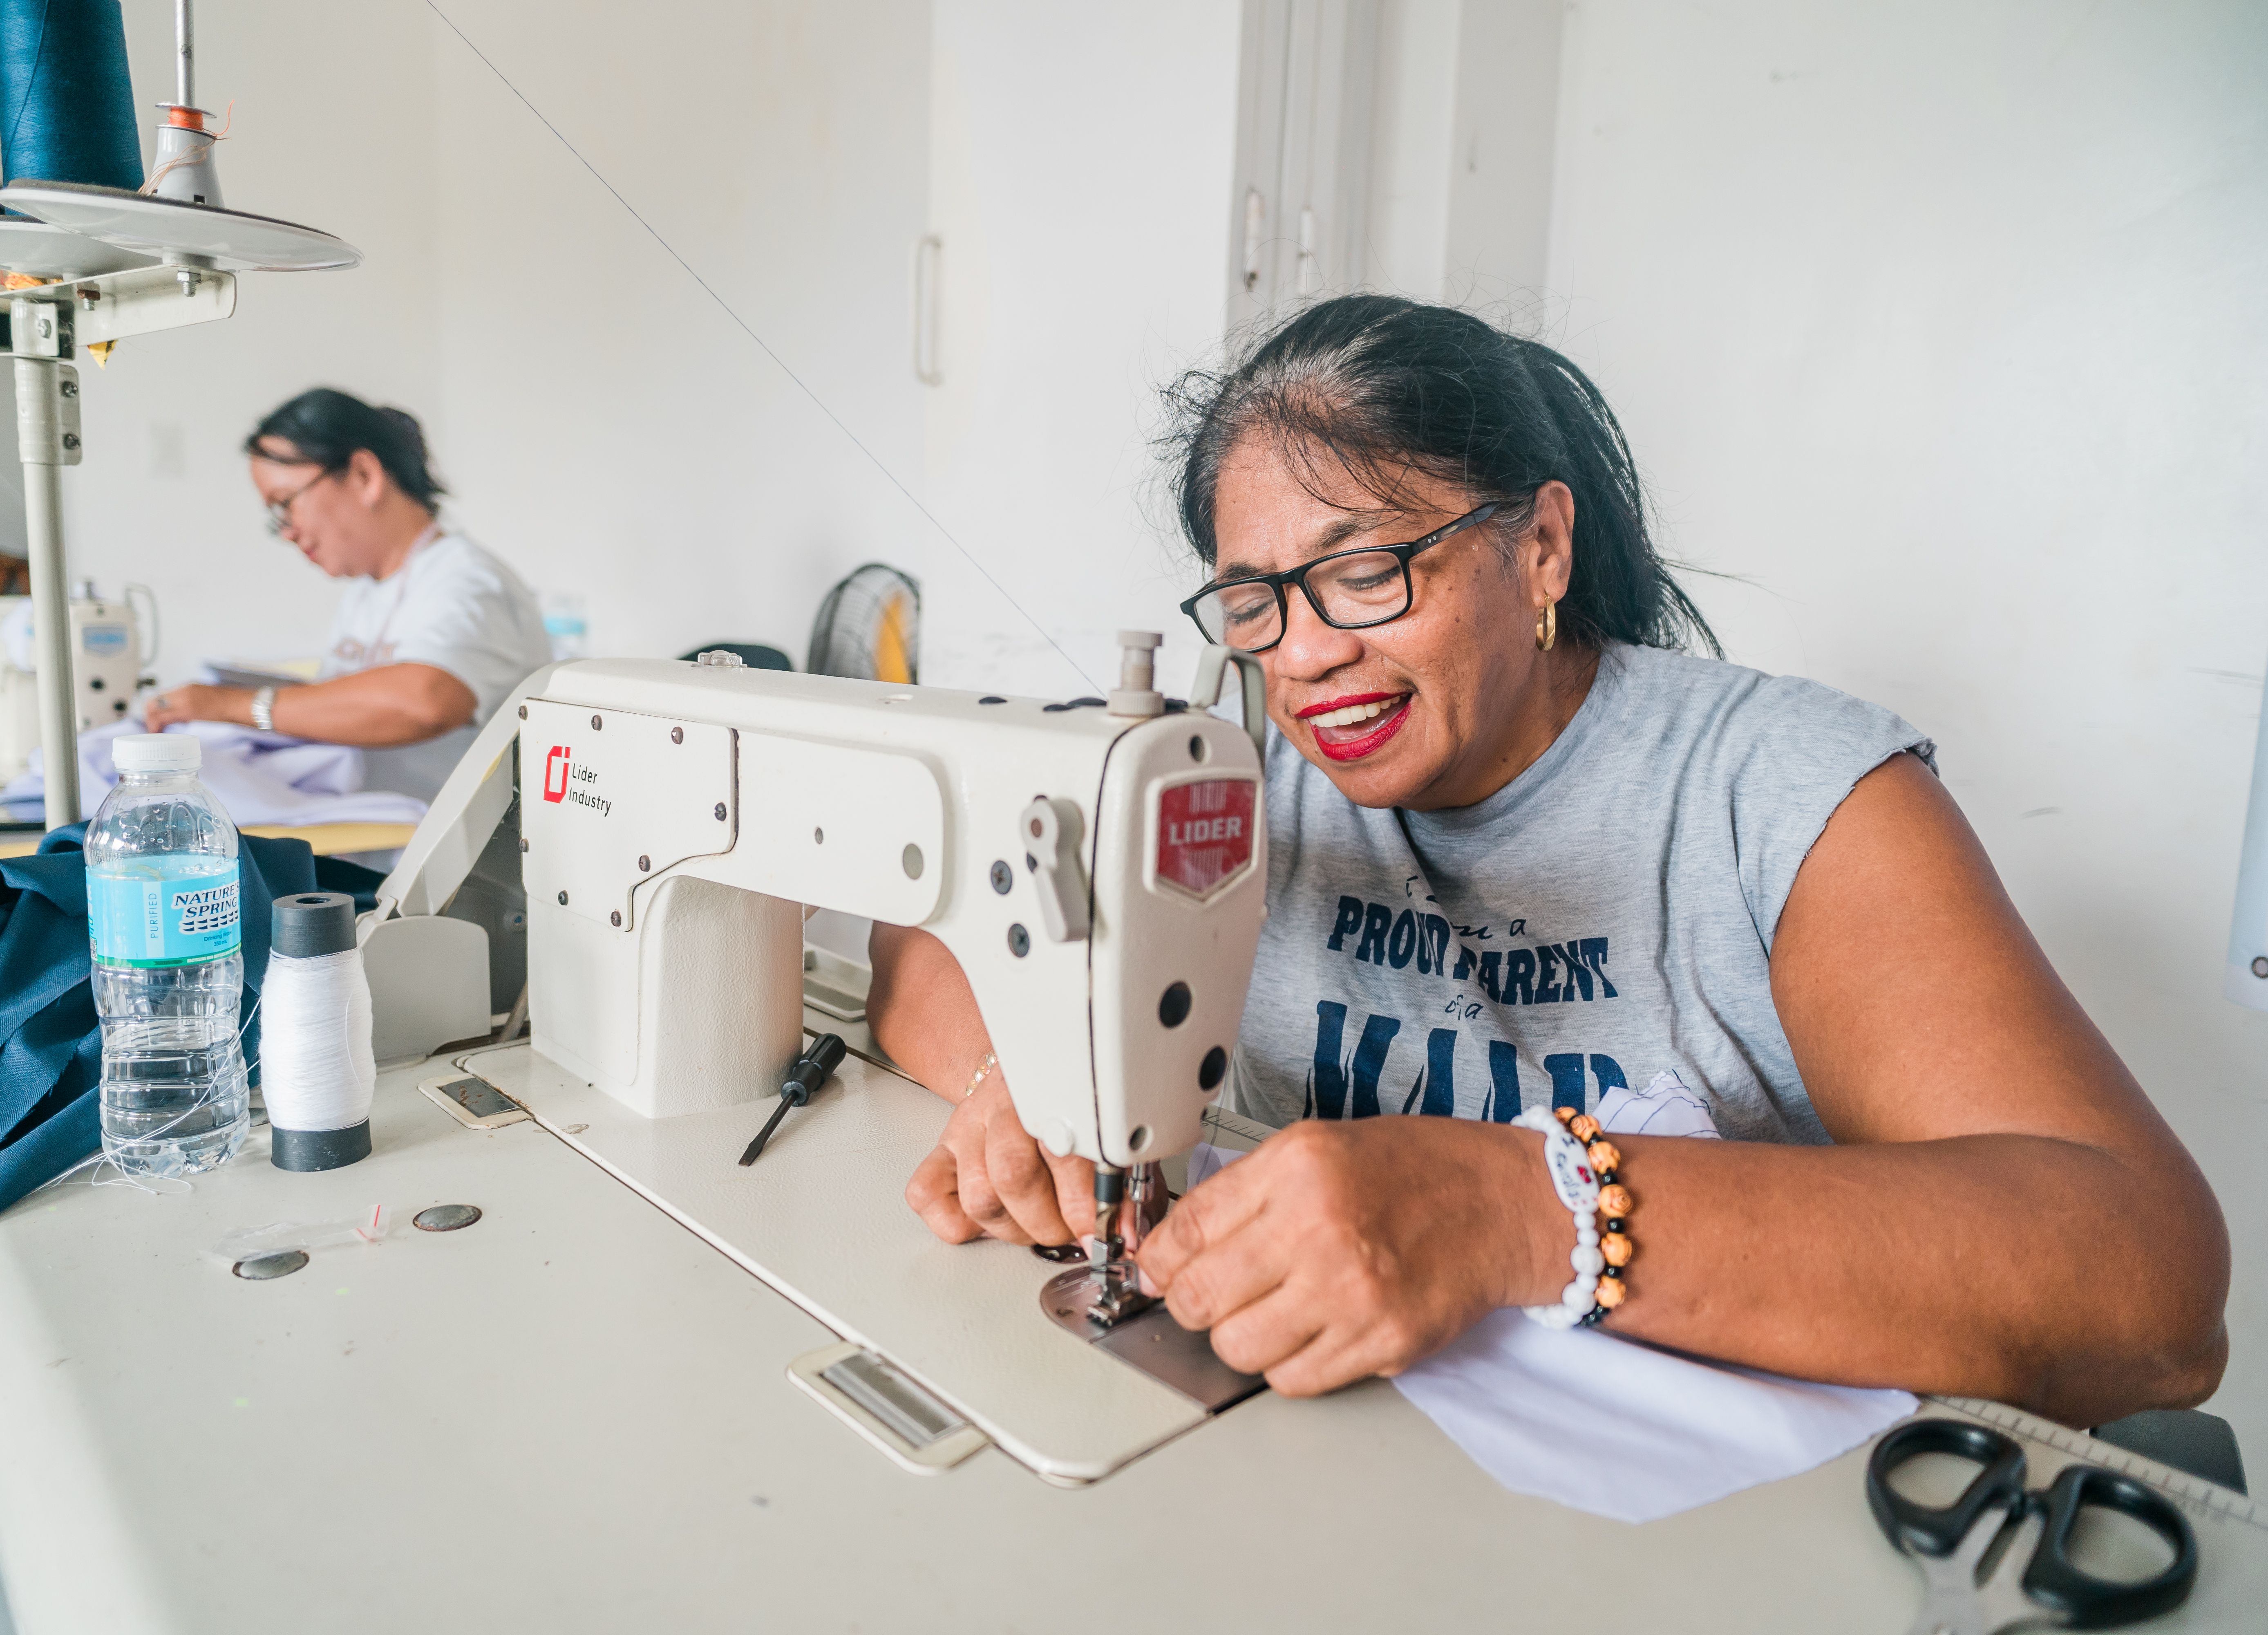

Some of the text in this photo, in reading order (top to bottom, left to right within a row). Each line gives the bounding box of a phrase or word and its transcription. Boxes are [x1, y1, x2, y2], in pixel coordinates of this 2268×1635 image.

[572, 763, 597, 784] Lider
[569, 786, 611, 817] Industry
[1168, 816, 1242, 846] LIDER
[174, 881, 239, 906] NATURE'S
[186, 896, 237, 918] SPRING
[148, 893, 159, 938] PURIFIED
[1510, 918, 1526, 937] a
[1326, 895, 1618, 1005] PROUD PARENT
[1445, 994, 1484, 1021] of a
